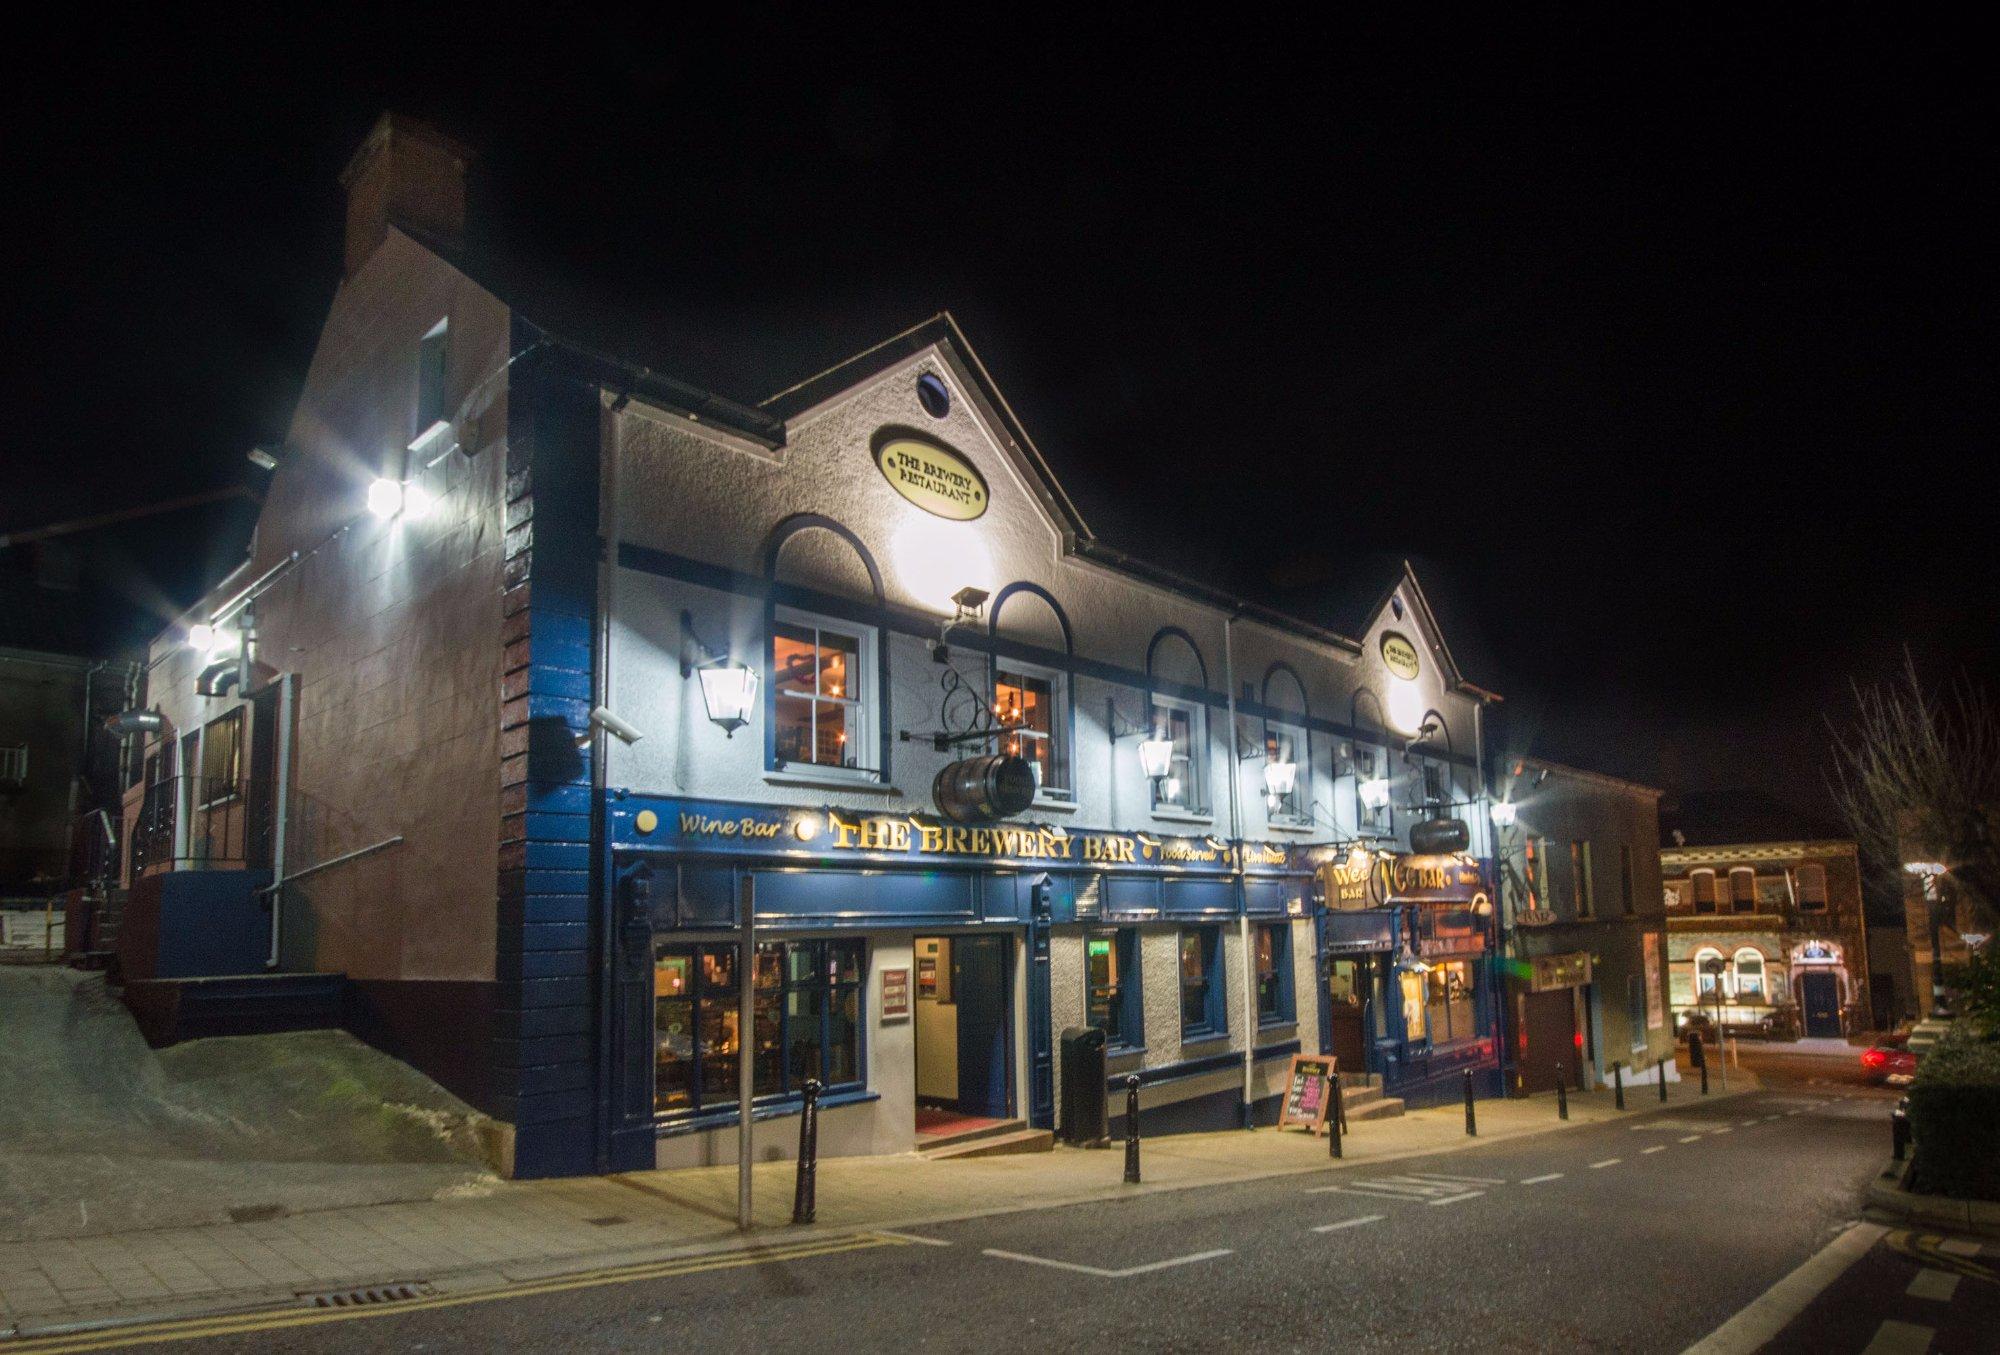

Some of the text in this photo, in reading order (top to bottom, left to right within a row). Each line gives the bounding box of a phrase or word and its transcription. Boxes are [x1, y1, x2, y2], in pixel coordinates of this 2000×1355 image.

[897, 451, 972, 491] THE BREWERY
[899, 468, 971, 504] RESTAURANT
[679, 812, 782, 838] Wine Bar
[830, 819, 1136, 863] THE BREWERY BAR
[1333, 866, 1369, 886] Wee
[1340, 888, 1364, 899] BAR
